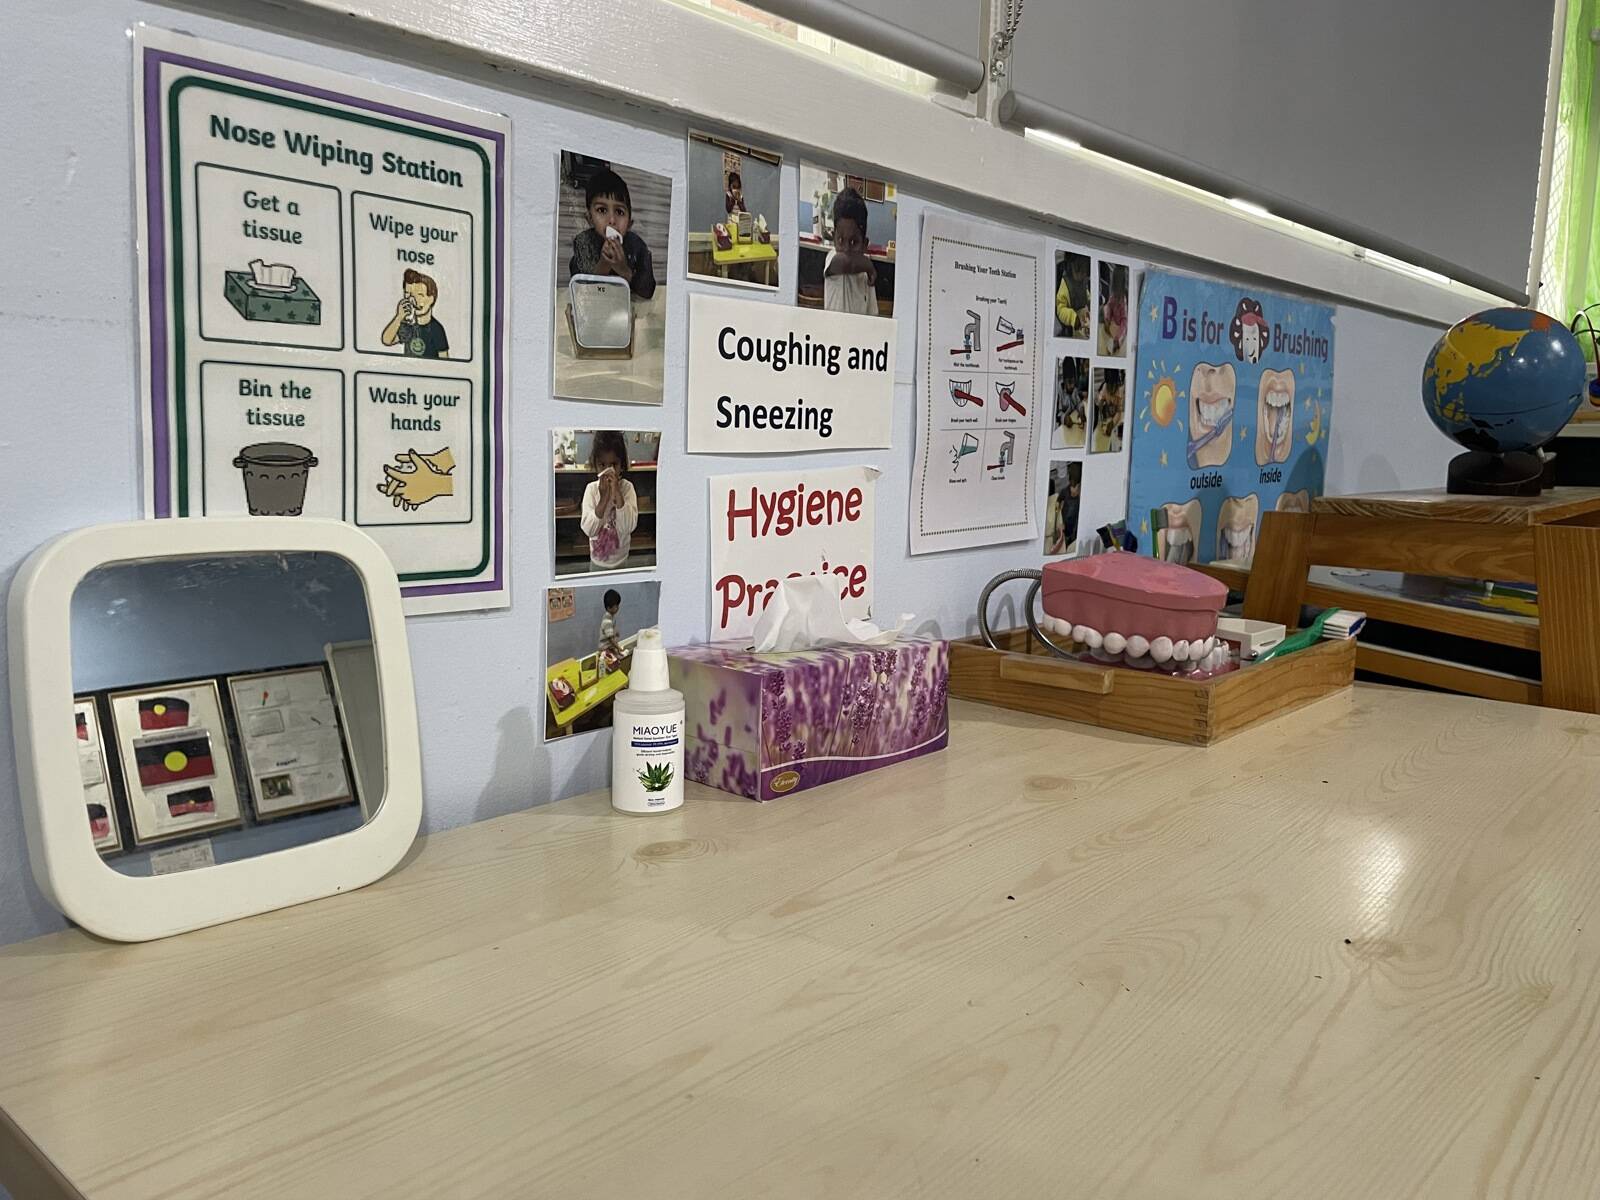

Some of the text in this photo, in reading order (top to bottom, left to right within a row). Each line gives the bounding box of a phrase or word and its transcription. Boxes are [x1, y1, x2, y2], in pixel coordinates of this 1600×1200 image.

[210, 114, 464, 188] Nose Wiping Station
[243, 190, 301, 216] Get a
[242, 220, 303, 245] tissue
[368, 212, 459, 244] Wipe your
[396, 248, 435, 266] nose
[954, 260, 977, 273] Brushing
[976, 264, 988, 274] Your
[989, 266, 1000, 276] Teeth
[1162, 295, 1329, 362] B is for Brushing
[718, 326, 889, 375] Coughing and
[238, 378, 312, 400] Bin the
[368, 386, 461, 411] Wash your
[246, 407, 306, 427] tissue
[391, 412, 441, 432] hands
[716, 395, 834, 438] Sneezing
[1190, 470, 1223, 489] outside
[1258, 465, 1283, 485] inside
[726, 483, 863, 542] Hygiene
[632, 724, 677, 735] MIAOYUE
